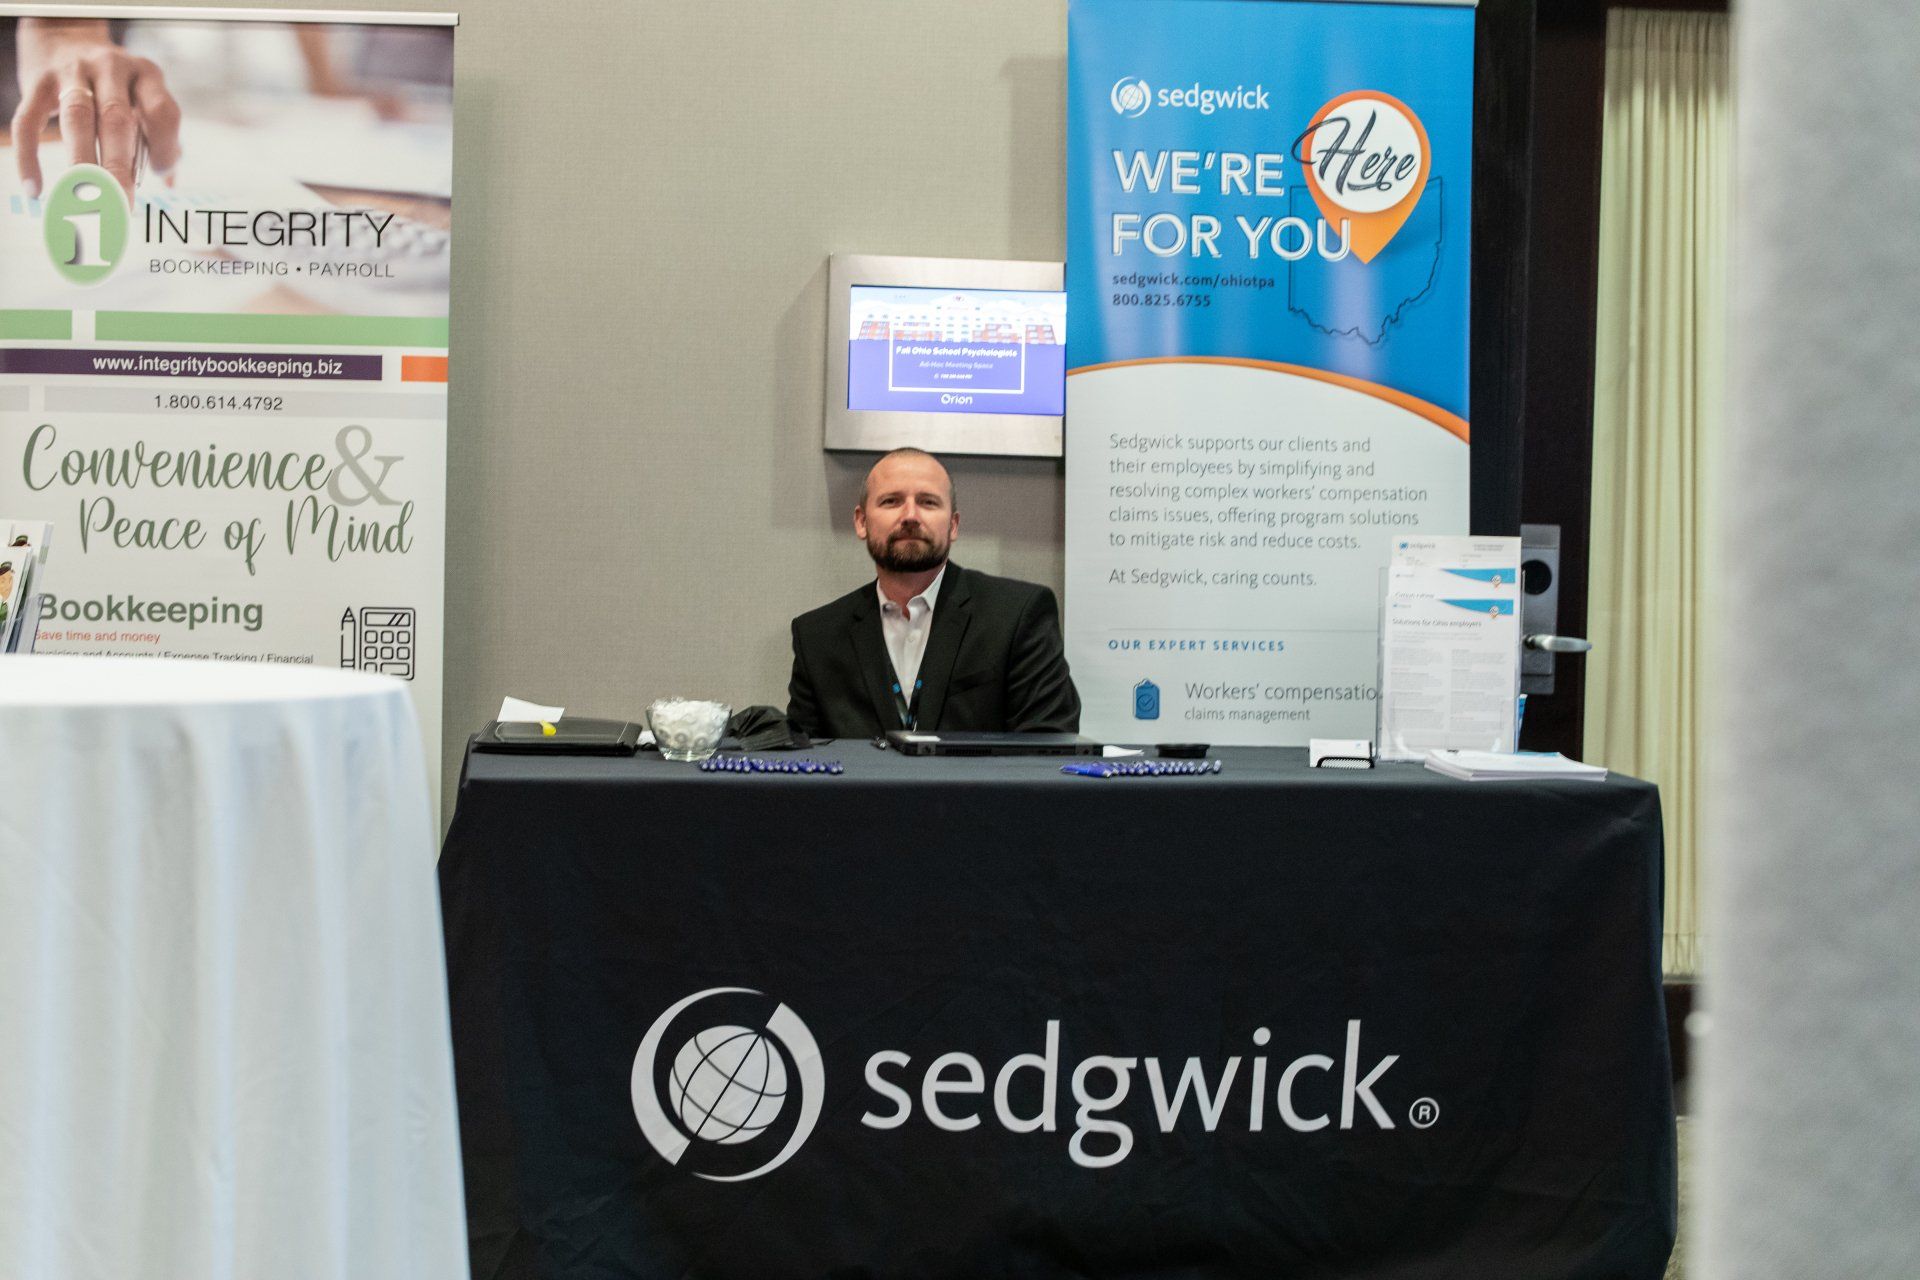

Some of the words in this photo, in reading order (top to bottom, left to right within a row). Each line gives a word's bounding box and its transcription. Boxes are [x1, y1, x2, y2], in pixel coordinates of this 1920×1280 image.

[1157, 82, 1269, 115] sedgwick
[1291, 109, 1417, 195] Here
[1112, 150, 1284, 197] WE’RE
[145, 203, 395, 248] INTEGRITY
[1112, 213, 1222, 259] FOR
[1236, 216, 1351, 262] YOU
[149, 258, 289, 277] BOOKKEEPING
[308, 261, 395, 279] PAYROLL
[1112, 271, 1275, 289] sedgwick.com/ohiotpa
[1112, 292, 1211, 307] 800.825.6755
[933, 347, 961, 357] School
[93, 355, 343, 378] www.integritybookkeeping.biz
[154, 394, 284, 412] 1.800.614.4792
[941, 393, 973, 405] Orion
[1109, 433, 1184, 452] Sedgwick
[1188, 436, 1254, 453] supports
[1258, 438, 1286, 451] our
[1288, 436, 1338, 452] clients
[1342, 438, 1371, 452] and
[22, 424, 333, 492] Convenience
[327, 425, 404, 506] &
[1109, 457, 1145, 475] their
[1151, 459, 1233, 477] employees
[1238, 460, 1256, 478] by
[1259, 460, 1342, 479] simplifying
[1346, 462, 1375, 477] and
[1110, 482, 1180, 501] resolving
[1185, 483, 1249, 503] complex
[1319, 487, 1428, 505] compensation
[1109, 507, 1159, 523] claims
[1163, 508, 1213, 525] issues,
[1217, 508, 1276, 527] offering
[1280, 513, 1345, 529] program
[1349, 509, 1419, 526] solutions
[80, 496, 207, 555] Peace
[224, 514, 267, 576] of
[286, 495, 414, 562] Mind
[1109, 533, 1126, 547] to
[1131, 532, 1195, 550] mitigate
[1200, 532, 1226, 548] risk
[1230, 532, 1258, 549] and
[1262, 533, 1313, 549] reduce
[1318, 534, 1362, 550] costs.
[1108, 569, 1127, 584] At
[1131, 568, 1208, 587] Sedgwick,
[1211, 570, 1258, 588] caring
[1262, 572, 1317, 587] counts.
[39, 593, 263, 632] Bookkeeping
[35, 630, 62, 641] Save
[66, 631, 91, 641] time
[95, 631, 117, 642] and
[121, 632, 161, 644] money
[1109, 639, 1141, 650] OUR
[1149, 640, 1205, 651] EXPERT
[1213, 640, 1285, 652] SERVICES
[267, 653, 313, 663] Financial
[1264, 683, 1380, 704] compensatio
[1184, 709, 1225, 720] claims
[1228, 711, 1310, 723] management
[860, 1019, 1399, 1169] sedgwick
